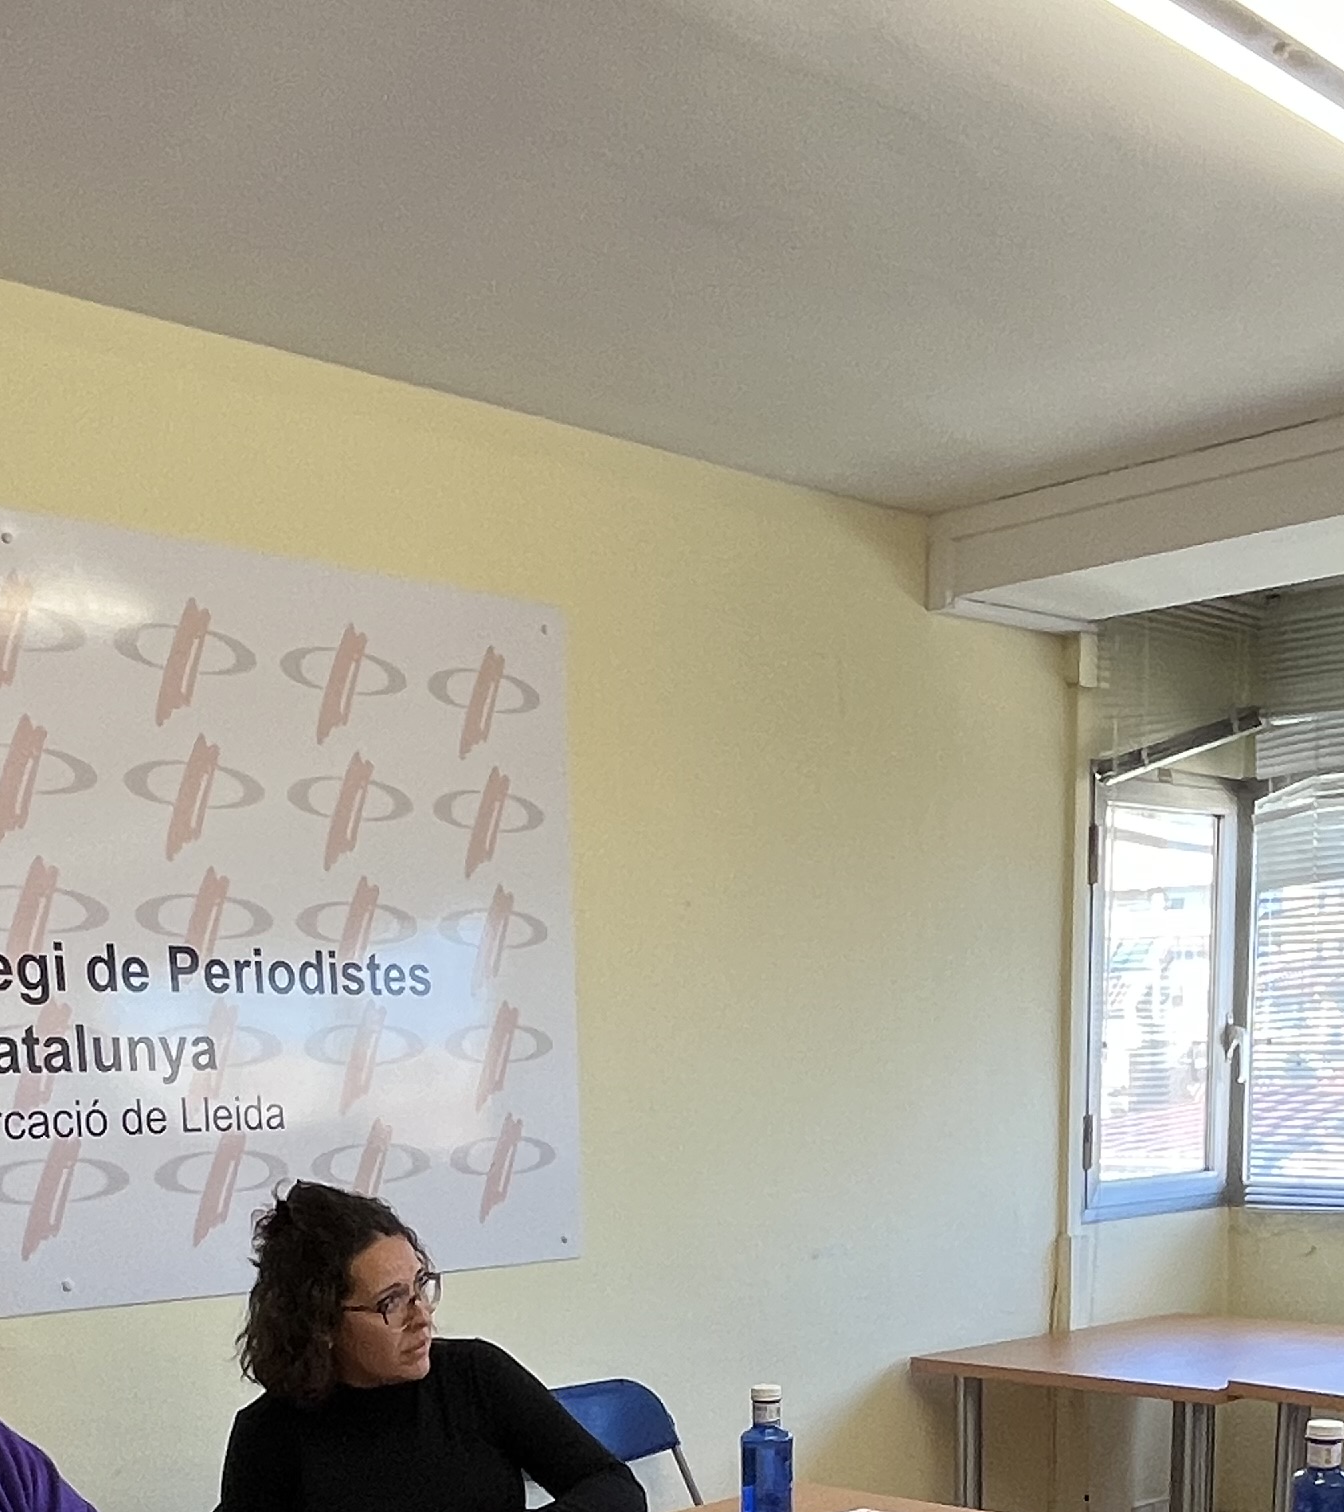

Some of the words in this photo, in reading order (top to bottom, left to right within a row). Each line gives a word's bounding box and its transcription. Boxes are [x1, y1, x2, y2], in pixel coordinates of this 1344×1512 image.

[87, 942, 150, 994] de
[169, 945, 432, 997] Periodistes
[122, 1100, 167, 1135] de
[181, 1096, 286, 1133] Lleida
